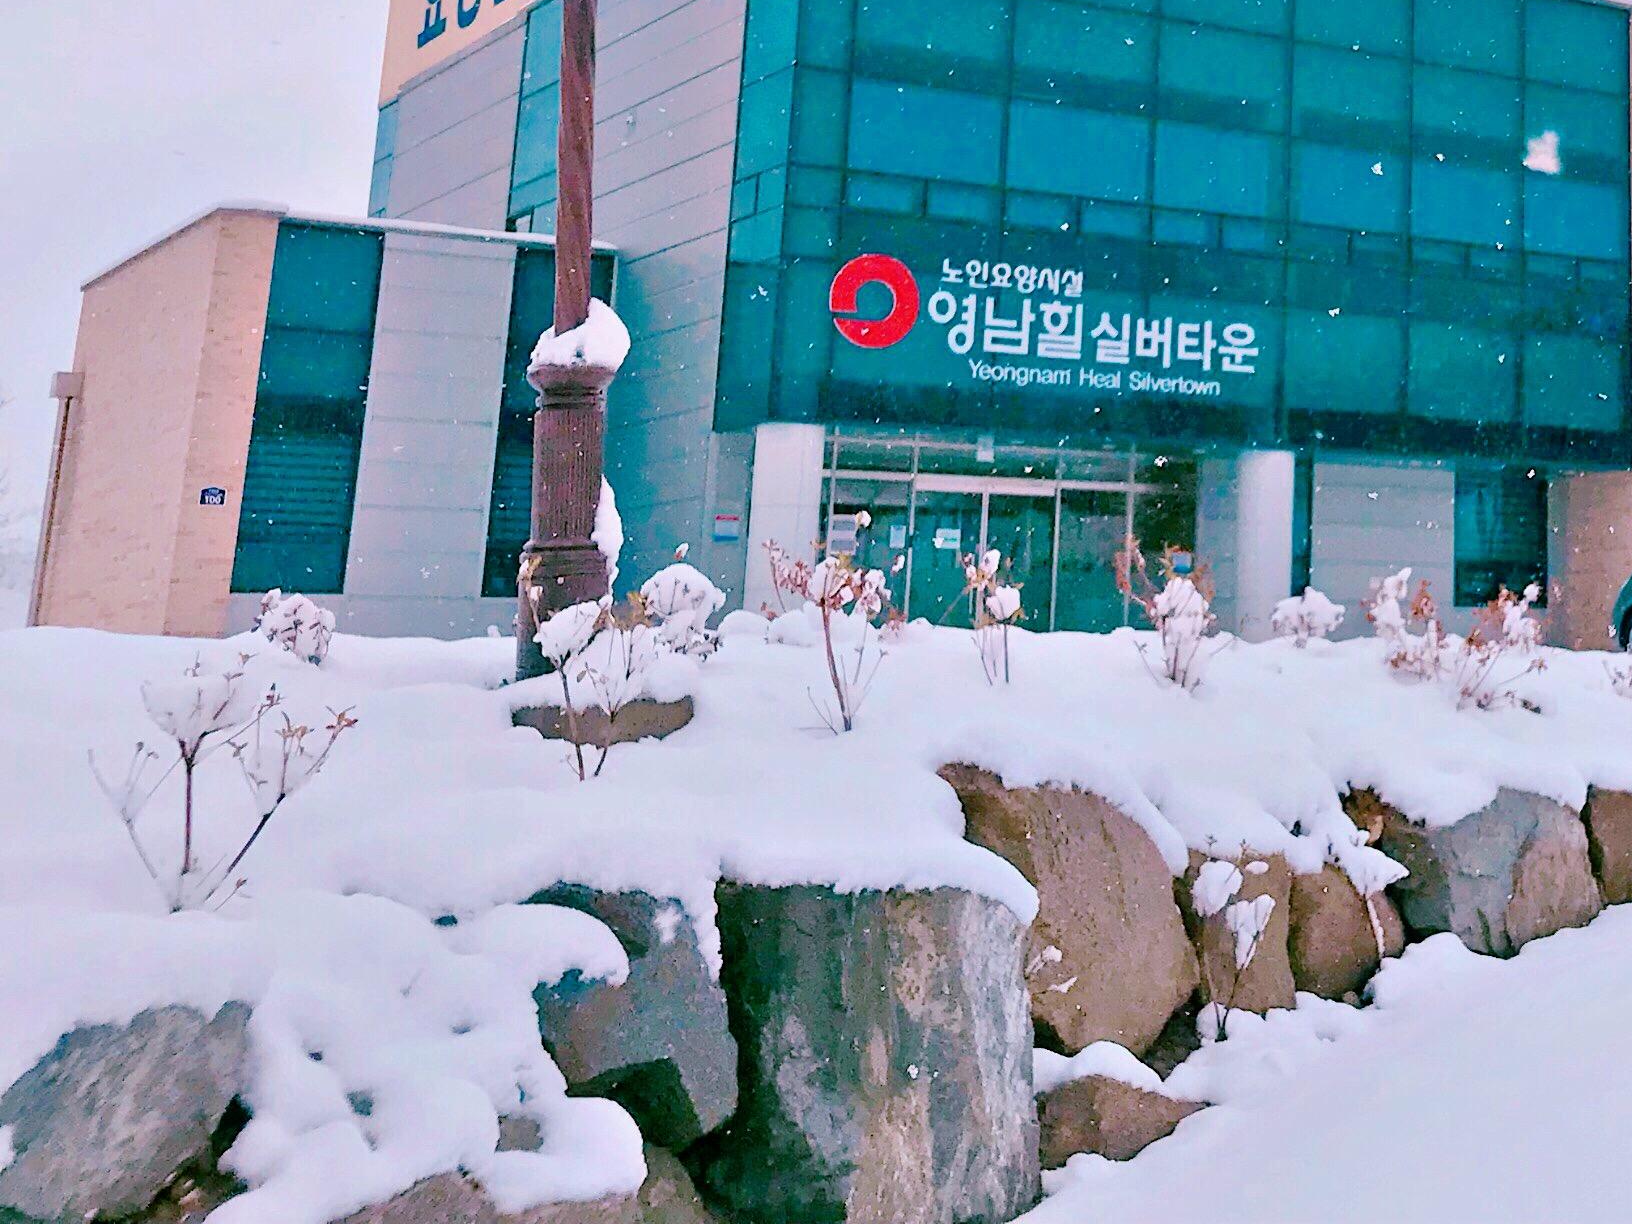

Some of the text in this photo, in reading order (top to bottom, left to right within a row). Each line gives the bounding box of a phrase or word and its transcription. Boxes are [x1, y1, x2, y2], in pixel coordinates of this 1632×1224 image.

[941, 257, 1084, 298] 노인요양시설
[927, 291, 1259, 374] 영남힐 실버타운
[968, 358, 1221, 396] Yeongnam Heal Silvertown
